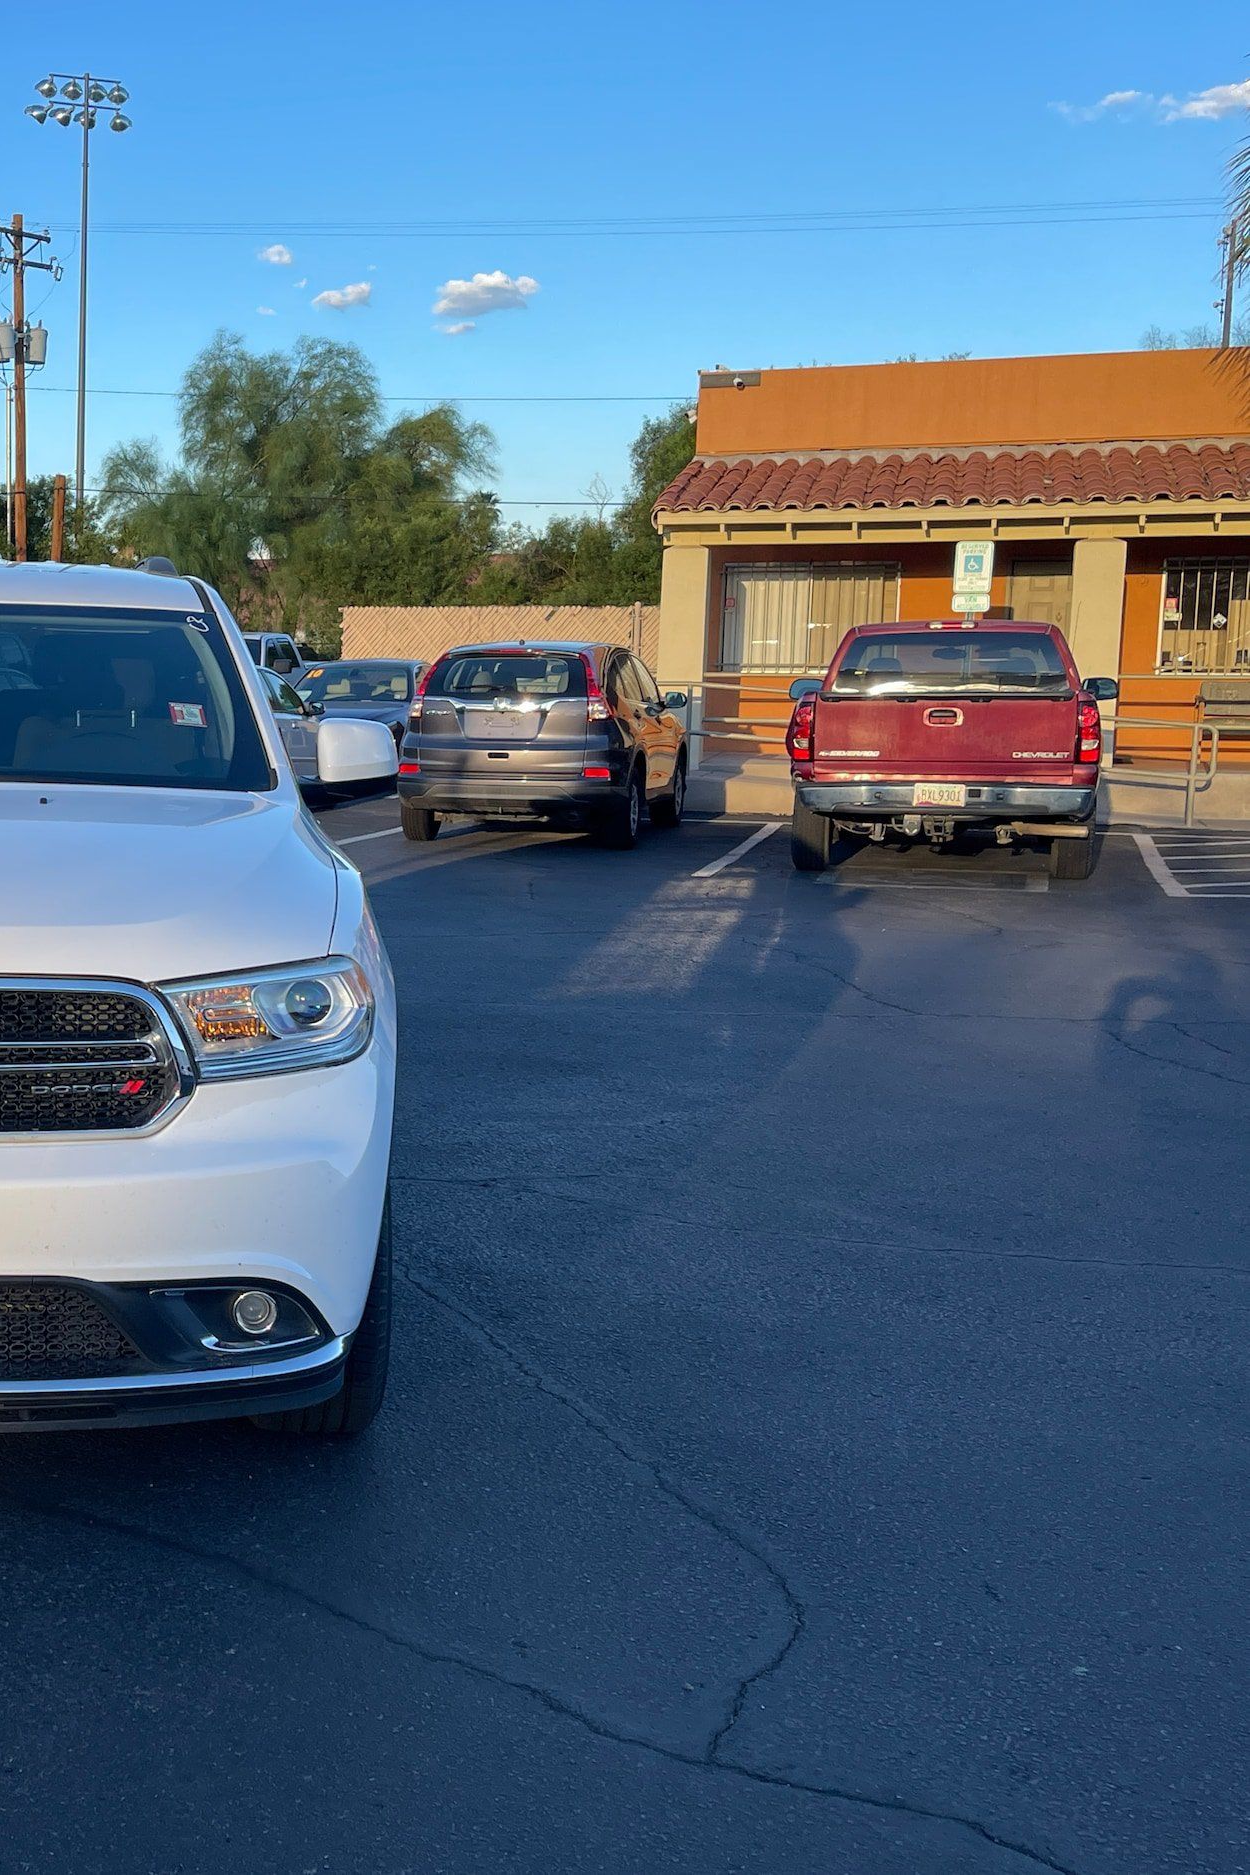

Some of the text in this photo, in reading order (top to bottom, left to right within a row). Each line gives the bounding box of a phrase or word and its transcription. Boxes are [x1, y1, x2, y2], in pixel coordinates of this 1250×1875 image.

[306, 669, 325, 679] 10
[1012, 751, 1070, 759] CHEVROLET
[921, 788, 961, 802] BXL9301
[31, 1083, 128, 1094] DODGE
